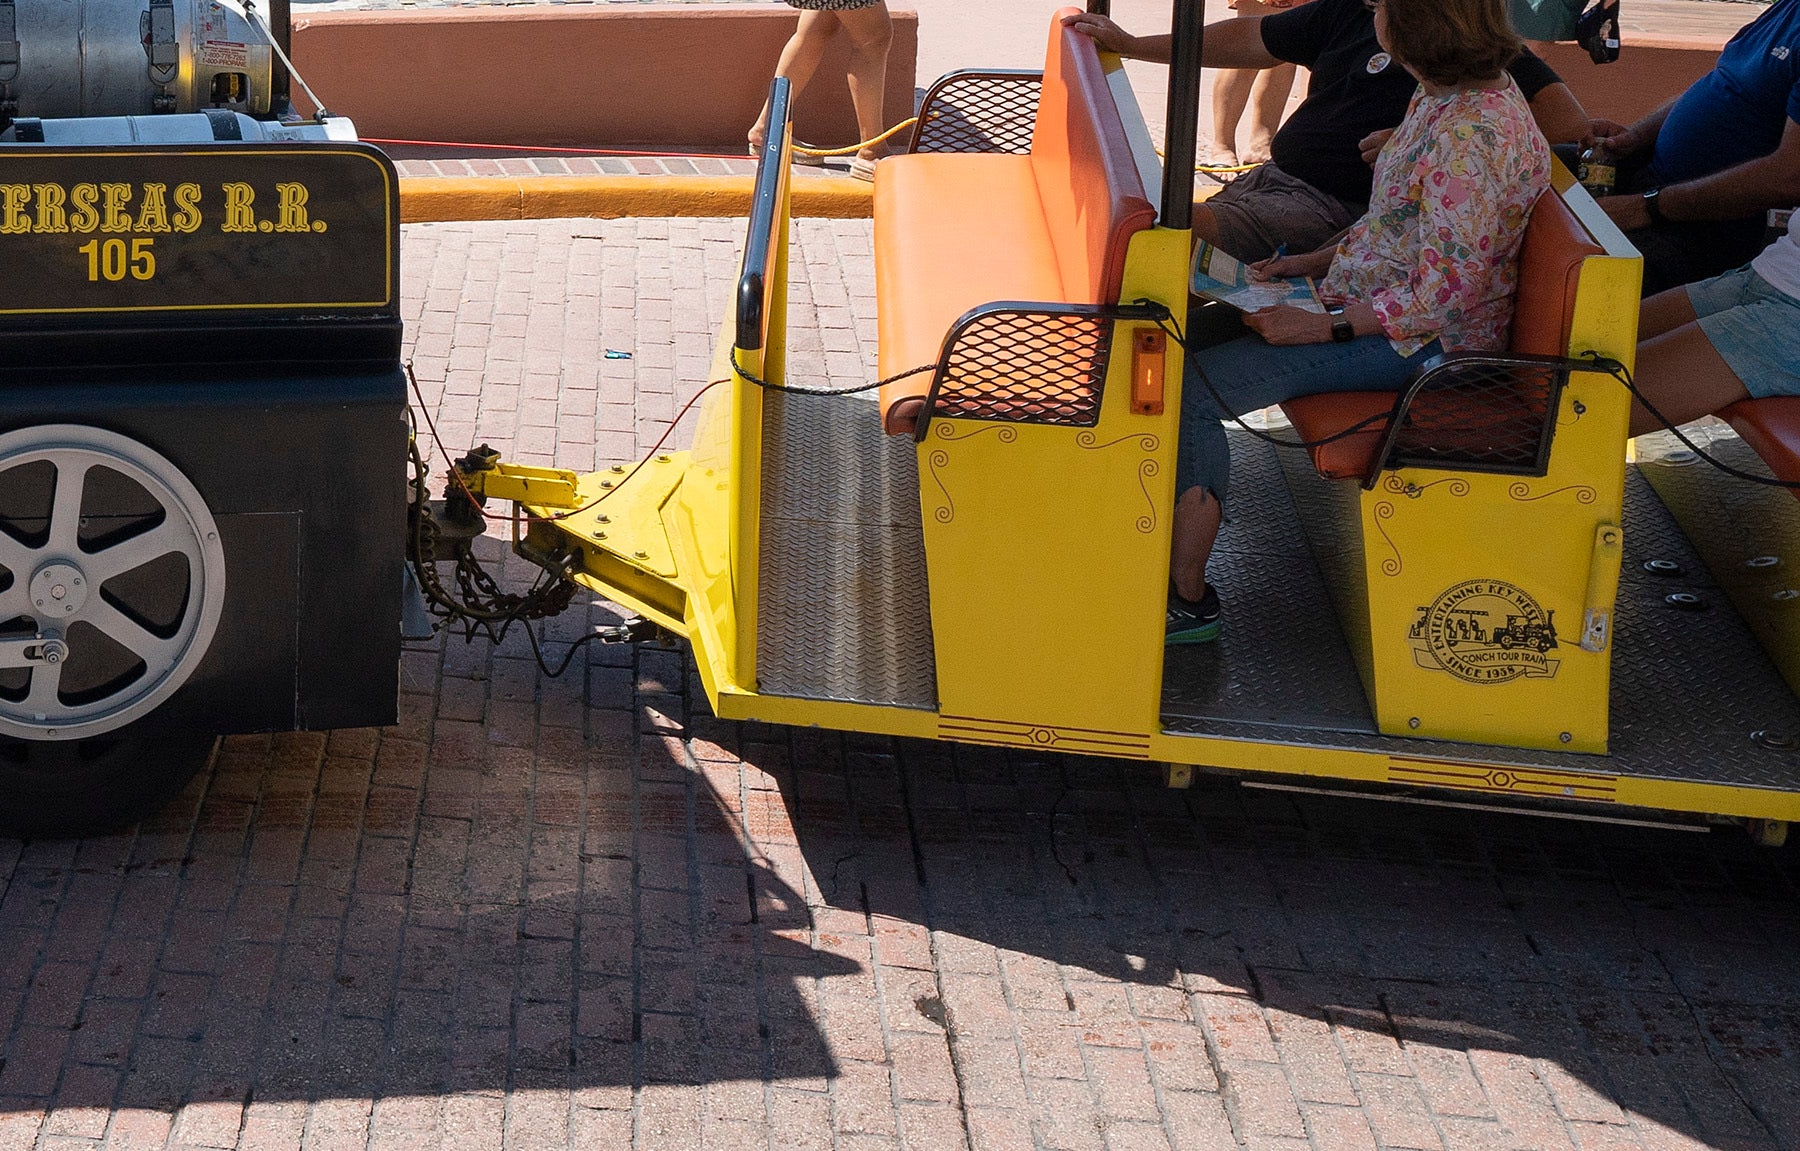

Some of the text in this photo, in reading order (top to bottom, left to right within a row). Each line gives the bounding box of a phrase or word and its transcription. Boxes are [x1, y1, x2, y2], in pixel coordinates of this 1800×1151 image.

[221, 182, 328, 234] R.R.
[79, 238, 156, 281] 105
[1431, 584, 1541, 650] ENTERTAINING KEY WEST
[1445, 656, 1516, 679] SINCE 1958
[1461, 652, 1546, 665] CONCH TOUR TRAIN
